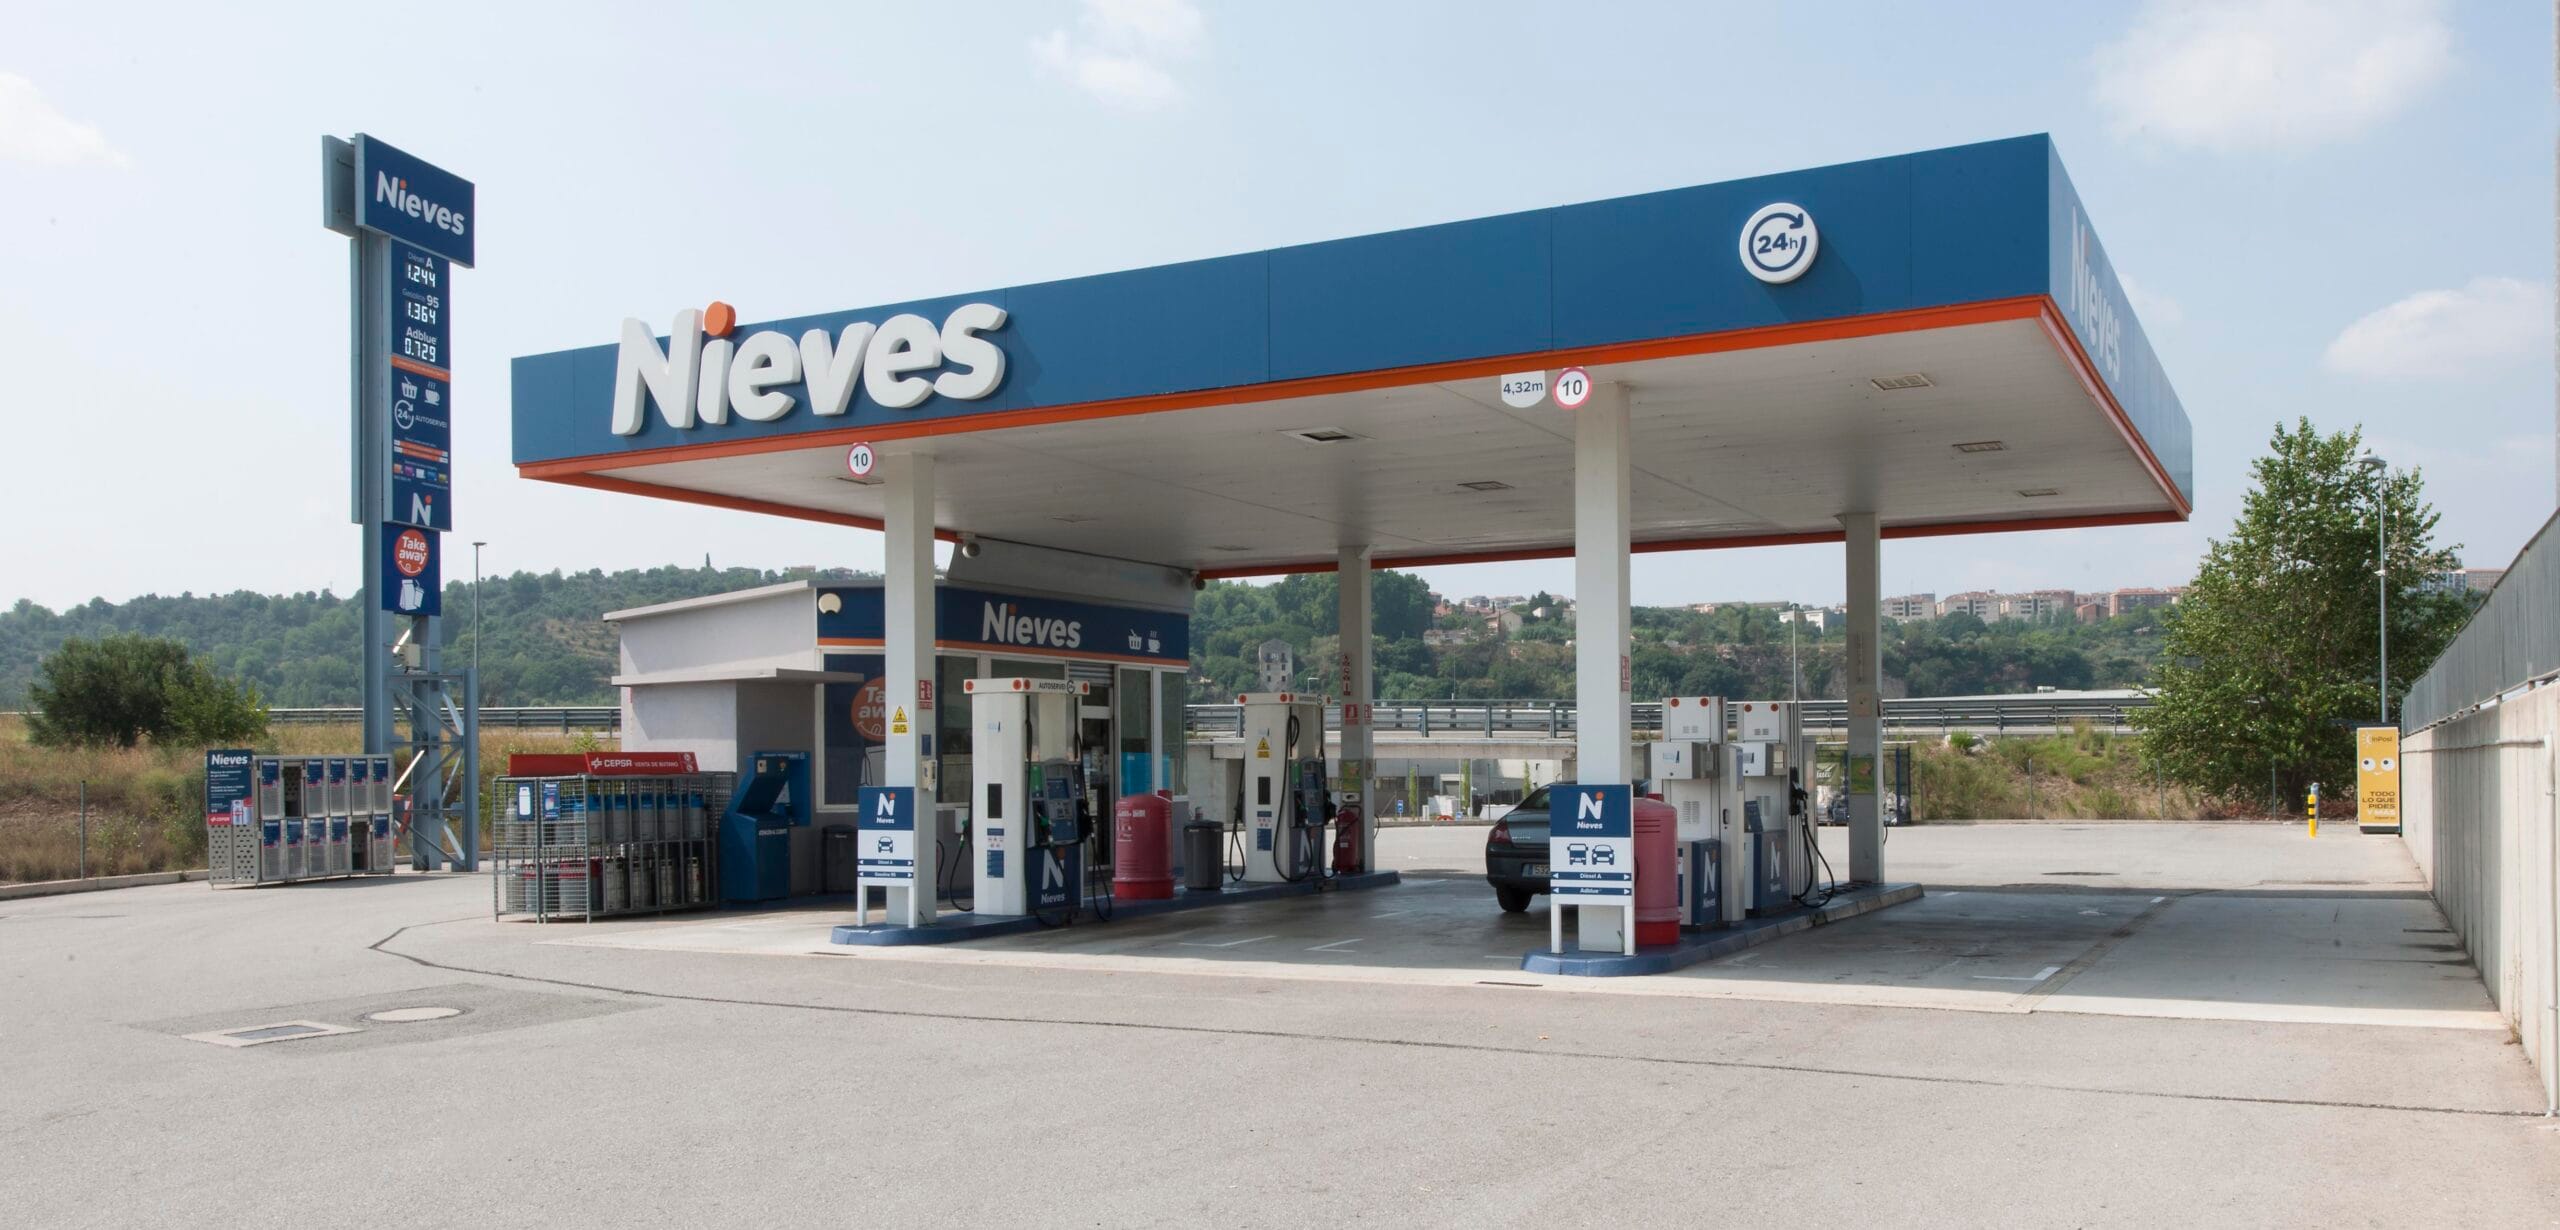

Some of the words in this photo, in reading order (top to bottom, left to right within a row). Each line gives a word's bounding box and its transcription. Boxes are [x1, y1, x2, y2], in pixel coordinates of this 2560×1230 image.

[376, 170, 465, 236] Nieves
[1757, 232, 1798, 254] 24h
[426, 257, 433, 269] A
[408, 263, 435, 288] 1.244
[426, 294, 439, 308] 95
[2071, 206, 2120, 383] Nieves
[408, 301, 436, 324] 1.364
[405, 338, 436, 362] 0.729
[611, 301, 1007, 436] Nieves
[1562, 379, 1583, 396] 10
[853, 453, 868, 467] 10
[402, 536, 425, 550] Take
[399, 550, 426, 565] away
[982, 601, 1081, 648] Nieves
[865, 686, 886, 703] Ta
[858, 706, 886, 718] aw
[211, 754, 248, 765] Nieves
[1577, 821, 1603, 829] Nieves
[1535, 864, 1550, 874] 532
[1041, 893, 1066, 904] Nieves
